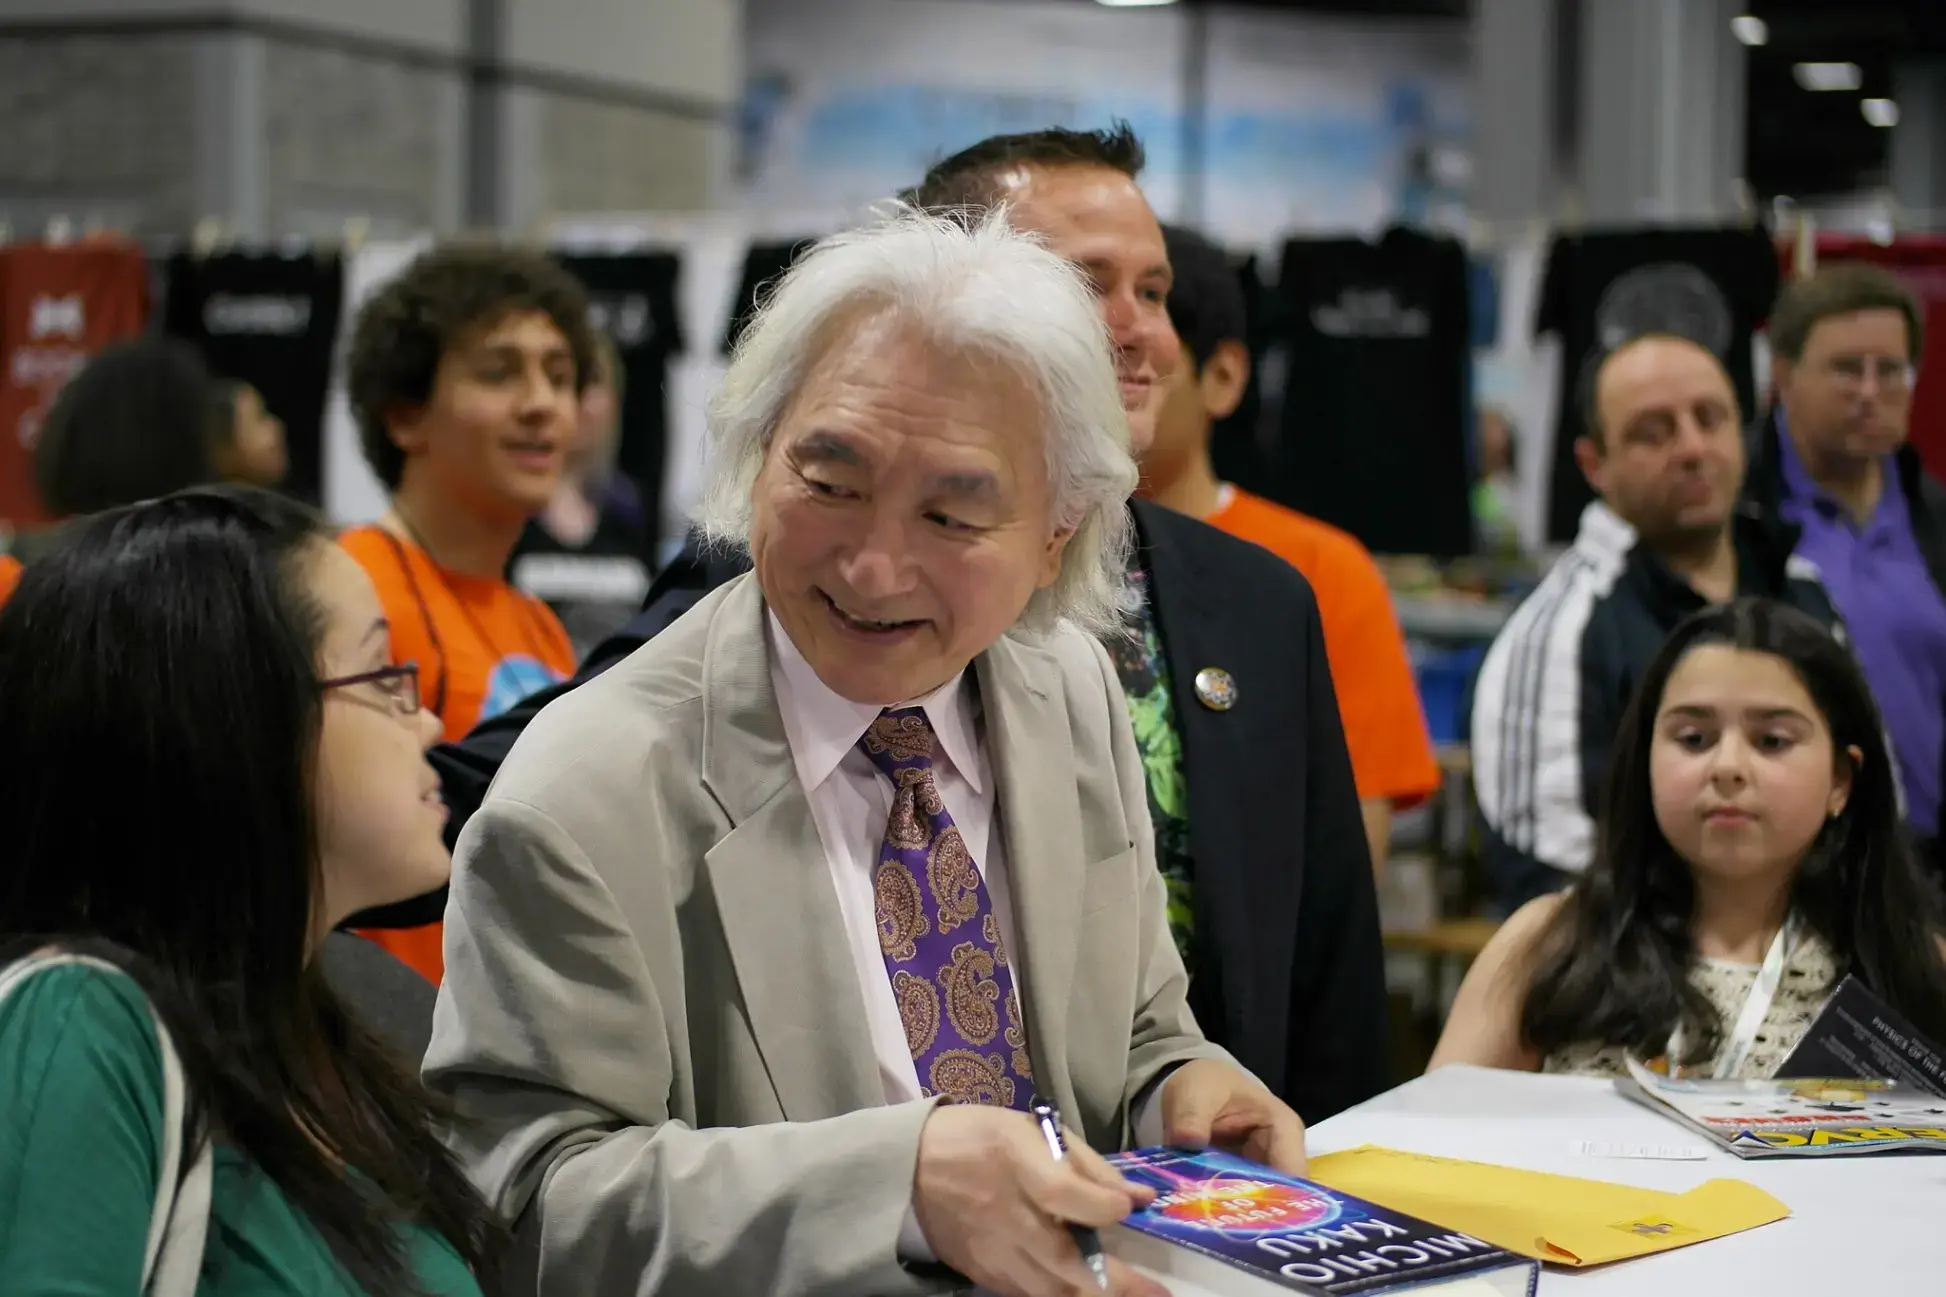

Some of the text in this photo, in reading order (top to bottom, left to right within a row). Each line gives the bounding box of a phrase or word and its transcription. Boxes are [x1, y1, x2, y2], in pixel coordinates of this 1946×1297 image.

[1872, 1016, 1909, 1050] PHYSICS
[1908, 1046, 1922, 1060] OF
[1182, 1207, 1288, 1229] FUTURE
[1221, 1197, 1256, 1211] OF
[1256, 1218, 1409, 1258] KAKU
[1280, 1232, 1493, 1284] MICHIO
